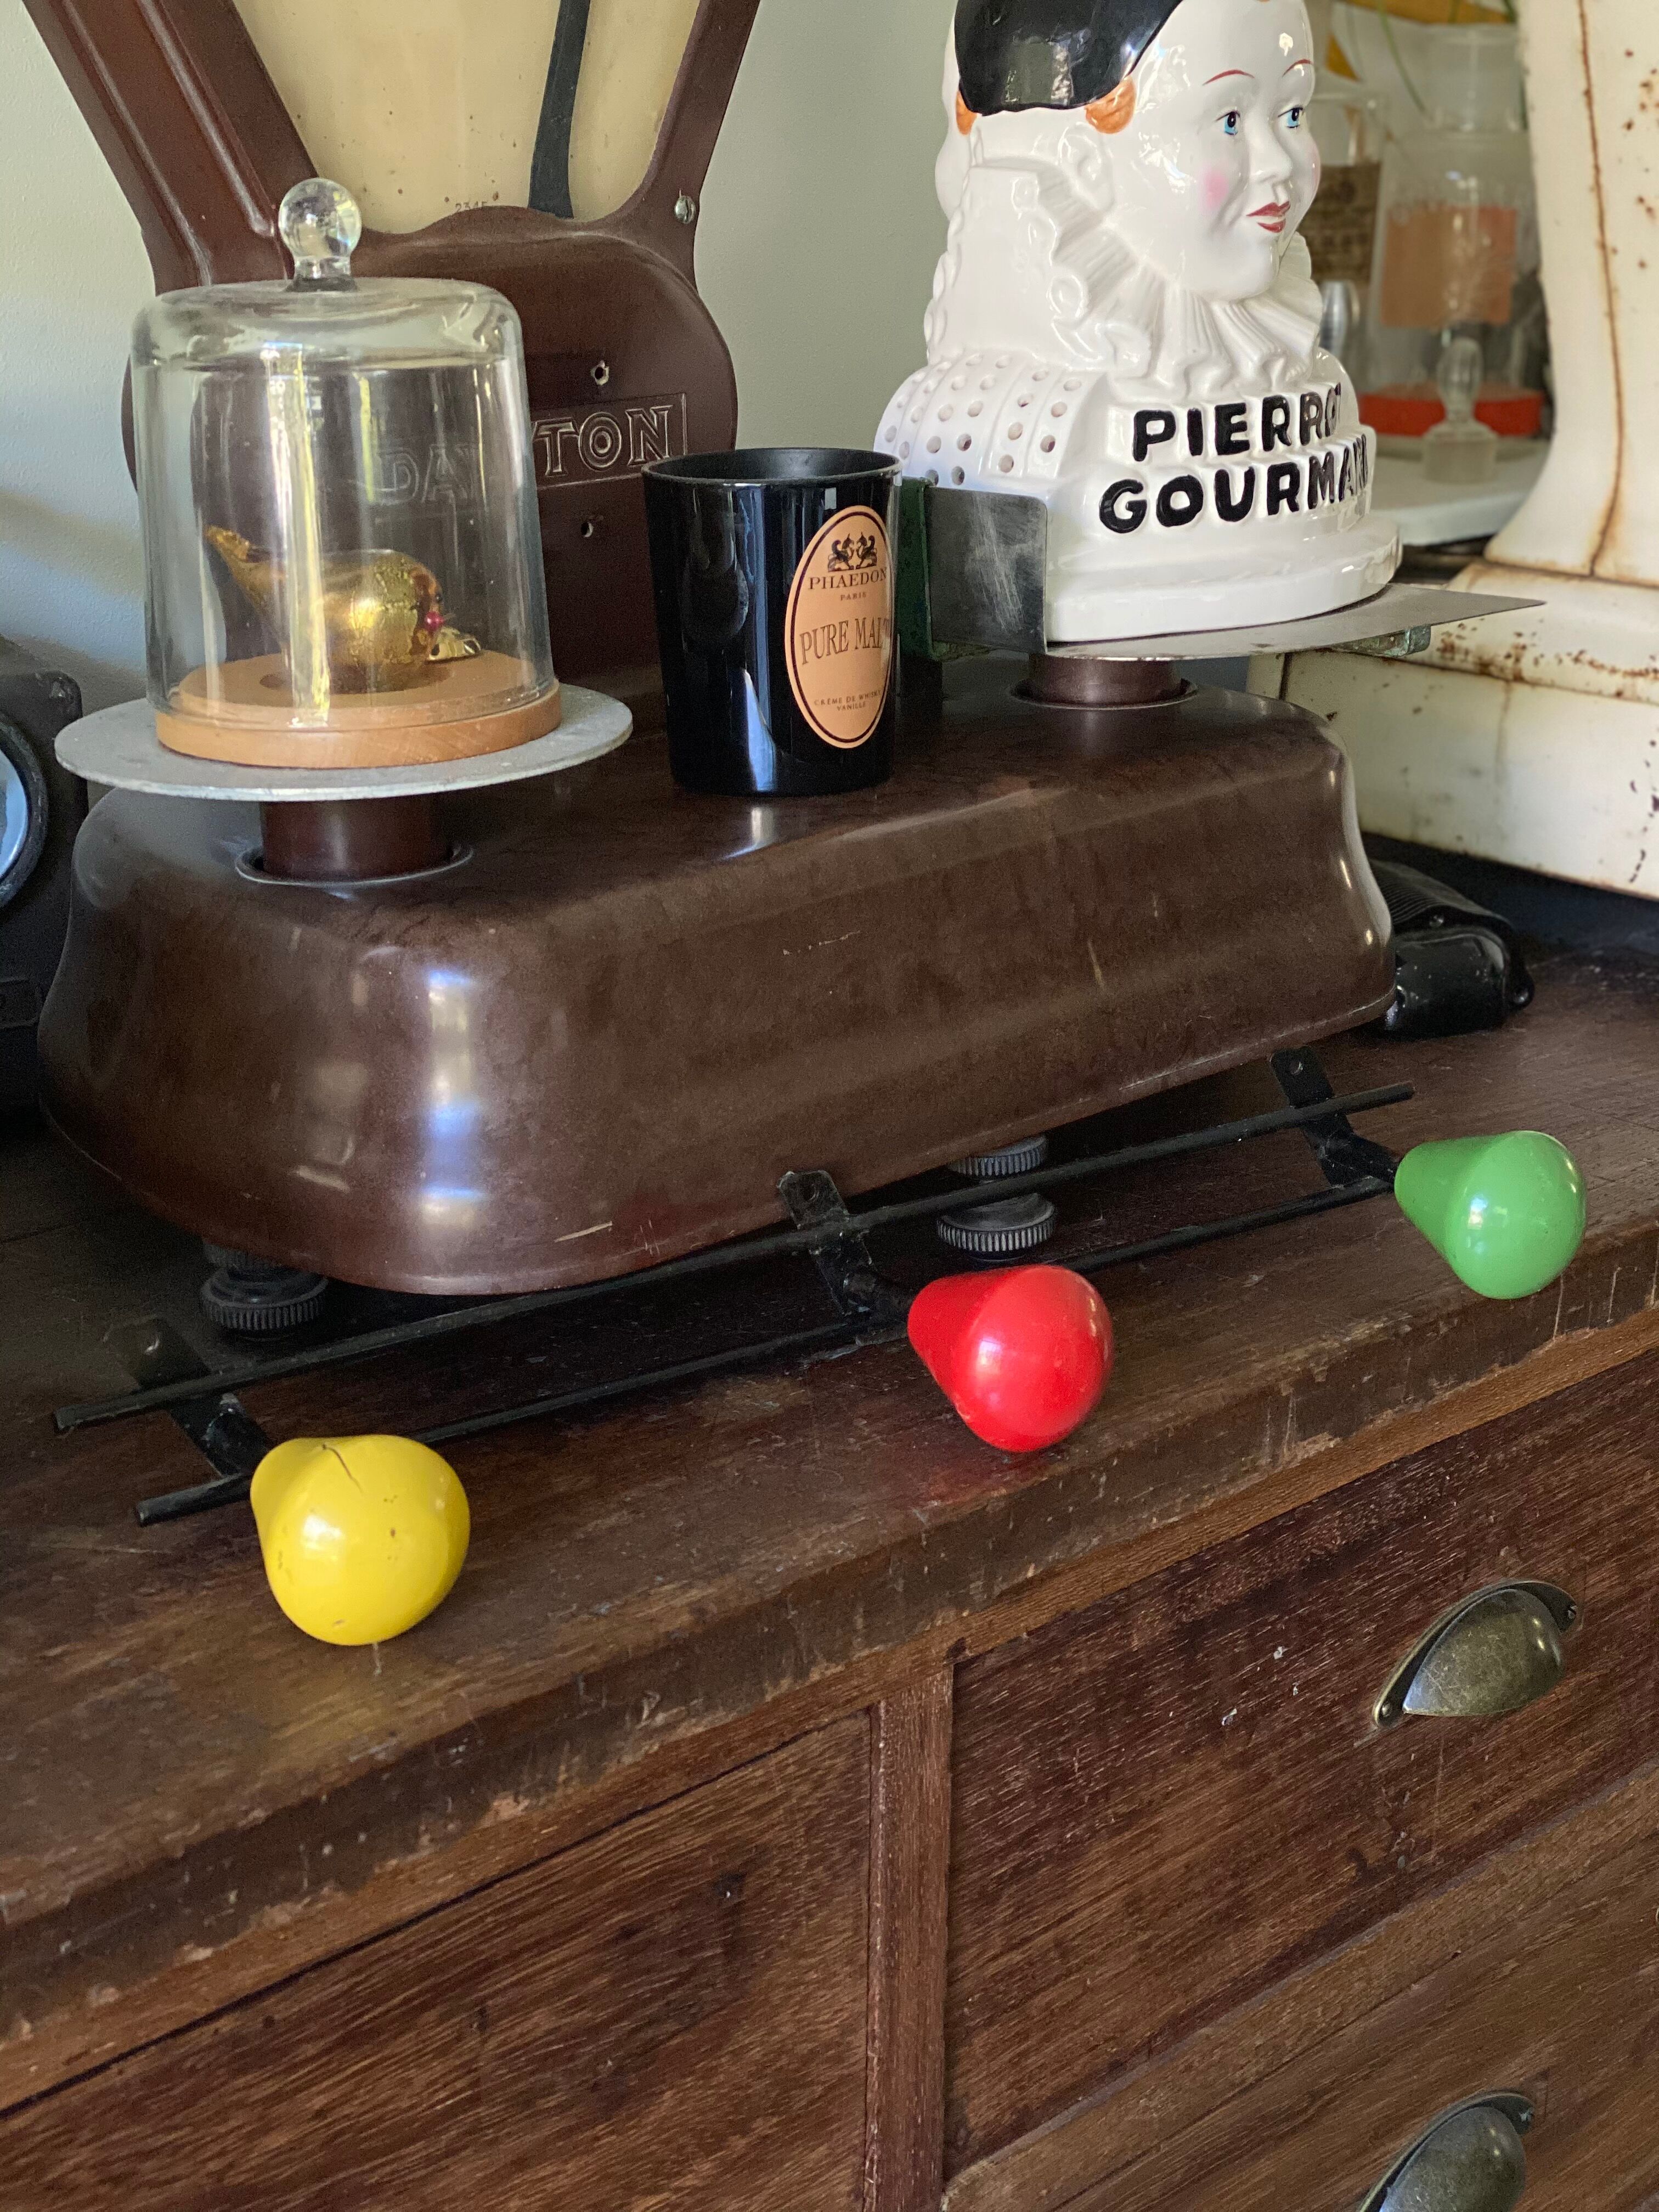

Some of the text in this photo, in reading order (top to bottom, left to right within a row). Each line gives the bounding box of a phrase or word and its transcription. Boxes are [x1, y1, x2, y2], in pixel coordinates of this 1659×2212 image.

[1099, 432, 1368, 533] GOURMAN
[808, 567, 887, 590] PHAEDON
[840, 591, 867, 601] PARIS
[799, 620, 849, 665] PURE
[837, 701, 866, 711] VANILLE
